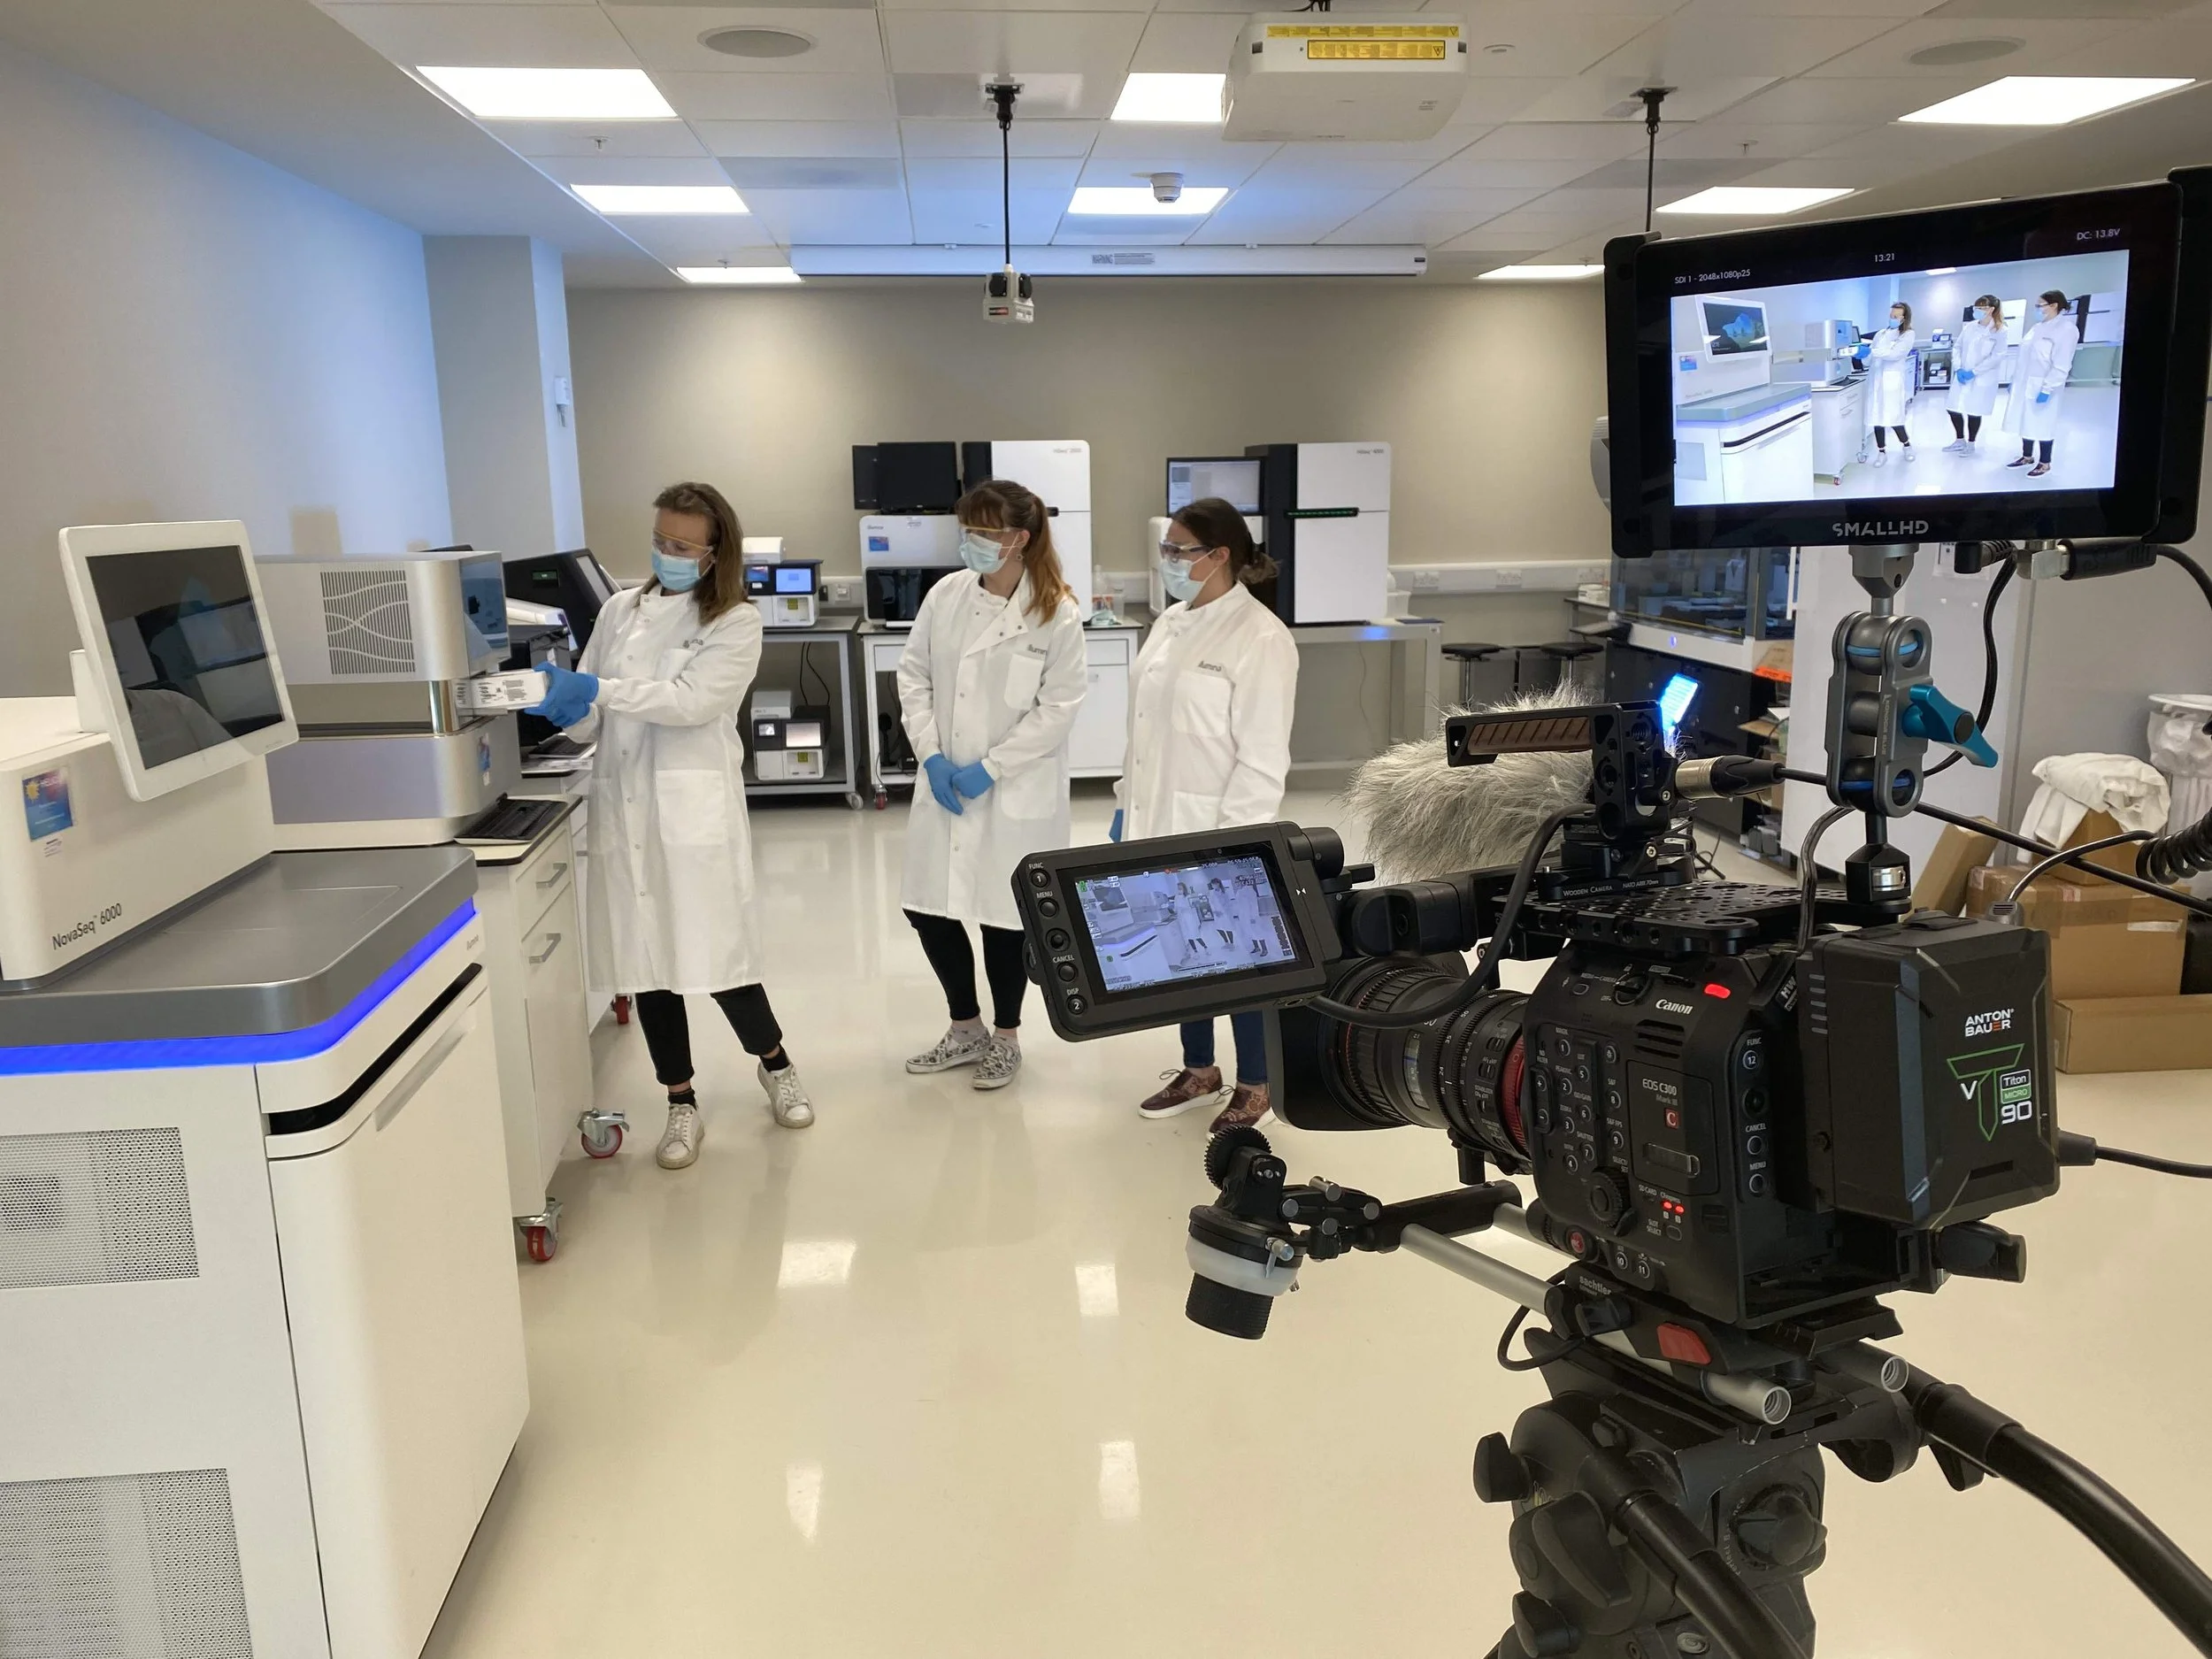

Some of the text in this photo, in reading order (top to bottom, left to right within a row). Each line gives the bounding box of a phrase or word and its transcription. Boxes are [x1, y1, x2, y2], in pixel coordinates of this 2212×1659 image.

[2095, 228, 2121, 239] 13.8V
[1874, 252, 1895, 263] 13:21
[1699, 269, 1751, 281] 2048x1080p25
[1832, 519, 1929, 537] SMALLHD
[1036, 874, 1042, 883] 1
[1036, 890, 1054, 899] MENU
[100, 902, 122, 926] 6000
[1052, 954, 1075, 964] CANCEL
[1073, 1001, 1080, 1010] 2
[1655, 999, 1694, 1015] Canon
[1965, 1009, 2010, 1027] ANTON
[1965, 1019, 2011, 1037] BAUER
[1747, 1037, 1762, 1046] FUNC
[1747, 1056, 1756, 1065] 12
[1642, 1078, 1678, 1096] EOS C300
[2004, 1087, 2028, 1100] MICRO
[2001, 1100, 2032, 1125] 90
[1667, 1111, 1677, 1126] C
[1745, 1123, 1767, 1133] CANCEL
[1577, 1131, 1594, 1141] SHUTTER
[1749, 1160, 1766, 1171] MENU
[1646, 1225, 1662, 1236] SELECT
[1617, 1256, 1624, 1266] 10
[1639, 1265, 1646, 1275] 11
[1579, 1275, 1612, 1295] sachtler
